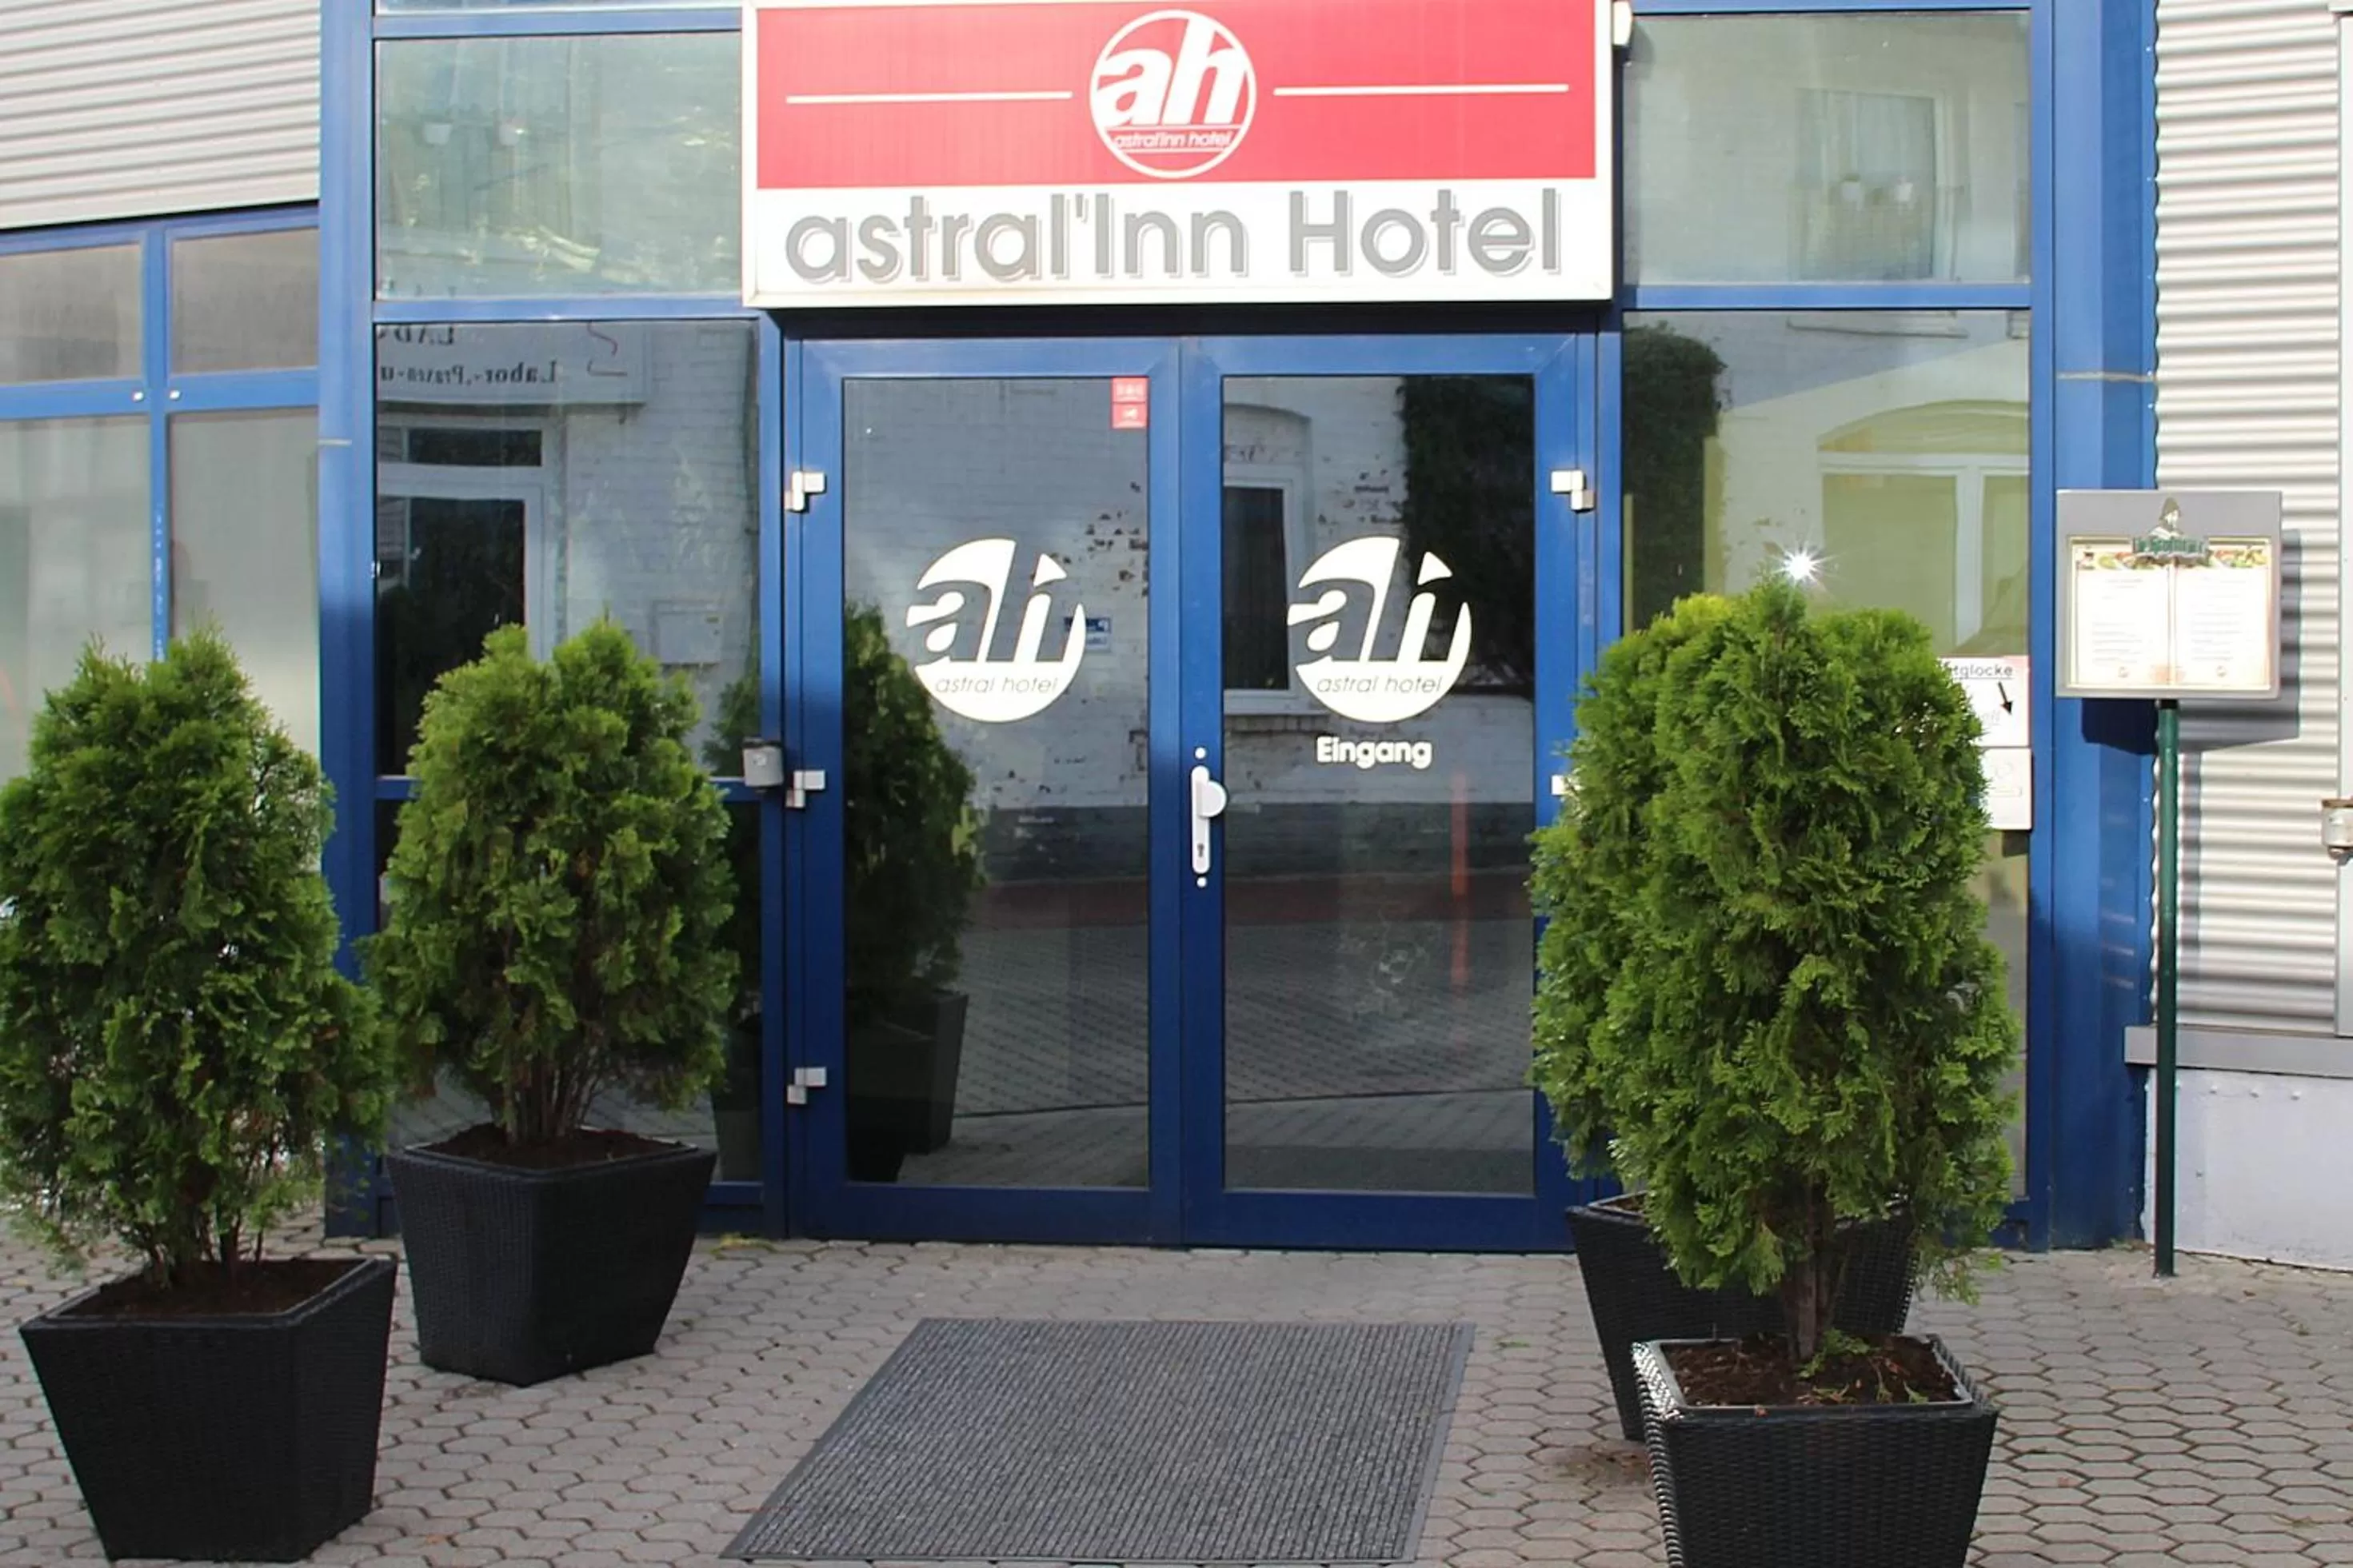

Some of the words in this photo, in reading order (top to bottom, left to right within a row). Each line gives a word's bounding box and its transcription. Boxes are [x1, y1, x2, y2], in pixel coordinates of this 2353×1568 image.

[1096, 18, 1249, 126] ah
[785, 192, 1249, 283] astral'Inn
[1288, 188, 1561, 277] Hotel
[934, 676, 995, 694] astral
[1001, 676, 1058, 694] hotel
[1316, 675, 1378, 693] astral
[1384, 675, 1443, 693] hotel
[1316, 736, 1433, 769] Eingang
